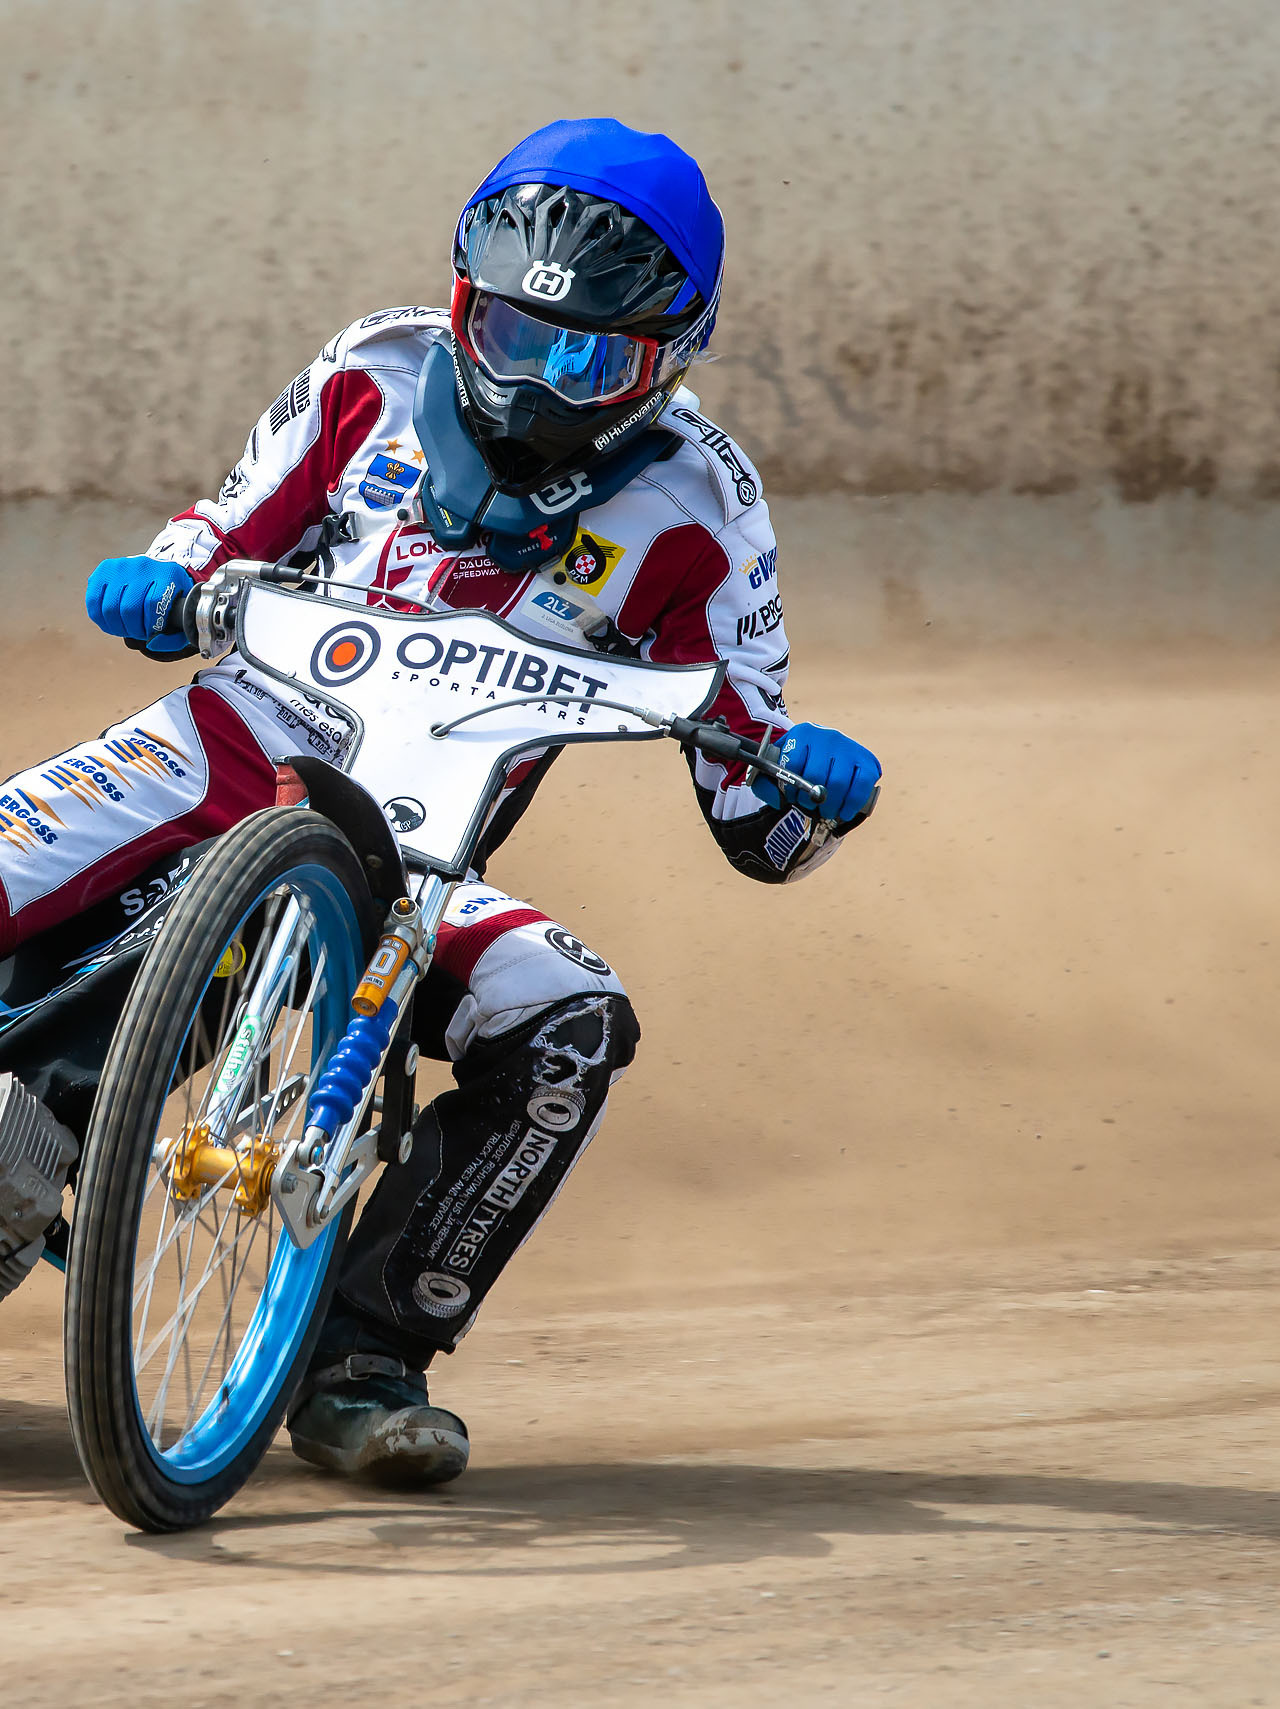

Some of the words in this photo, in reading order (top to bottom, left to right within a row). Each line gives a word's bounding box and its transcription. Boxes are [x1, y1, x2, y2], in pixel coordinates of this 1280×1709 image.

[609, 391, 662, 440] Husqvarna
[453, 568, 500, 580] SPEEDWAY
[570, 569, 588, 583] PZM
[544, 596, 570, 617] 2LŻ
[396, 632, 608, 714] OPTIBET
[391, 671, 496, 700] SPORTA
[519, 701, 586, 726] ĀRS
[130, 738, 187, 778] ERGOSS
[63, 758, 125, 802] ERGOSS
[479, 1131, 502, 1159] TRUCK
[461, 1156, 484, 1181] TYRES
[490, 1132, 551, 1206] NORTH
[448, 1179, 465, 1197] AND
[429, 1196, 454, 1230] SERVICE
[449, 1203, 502, 1269] TYRES
